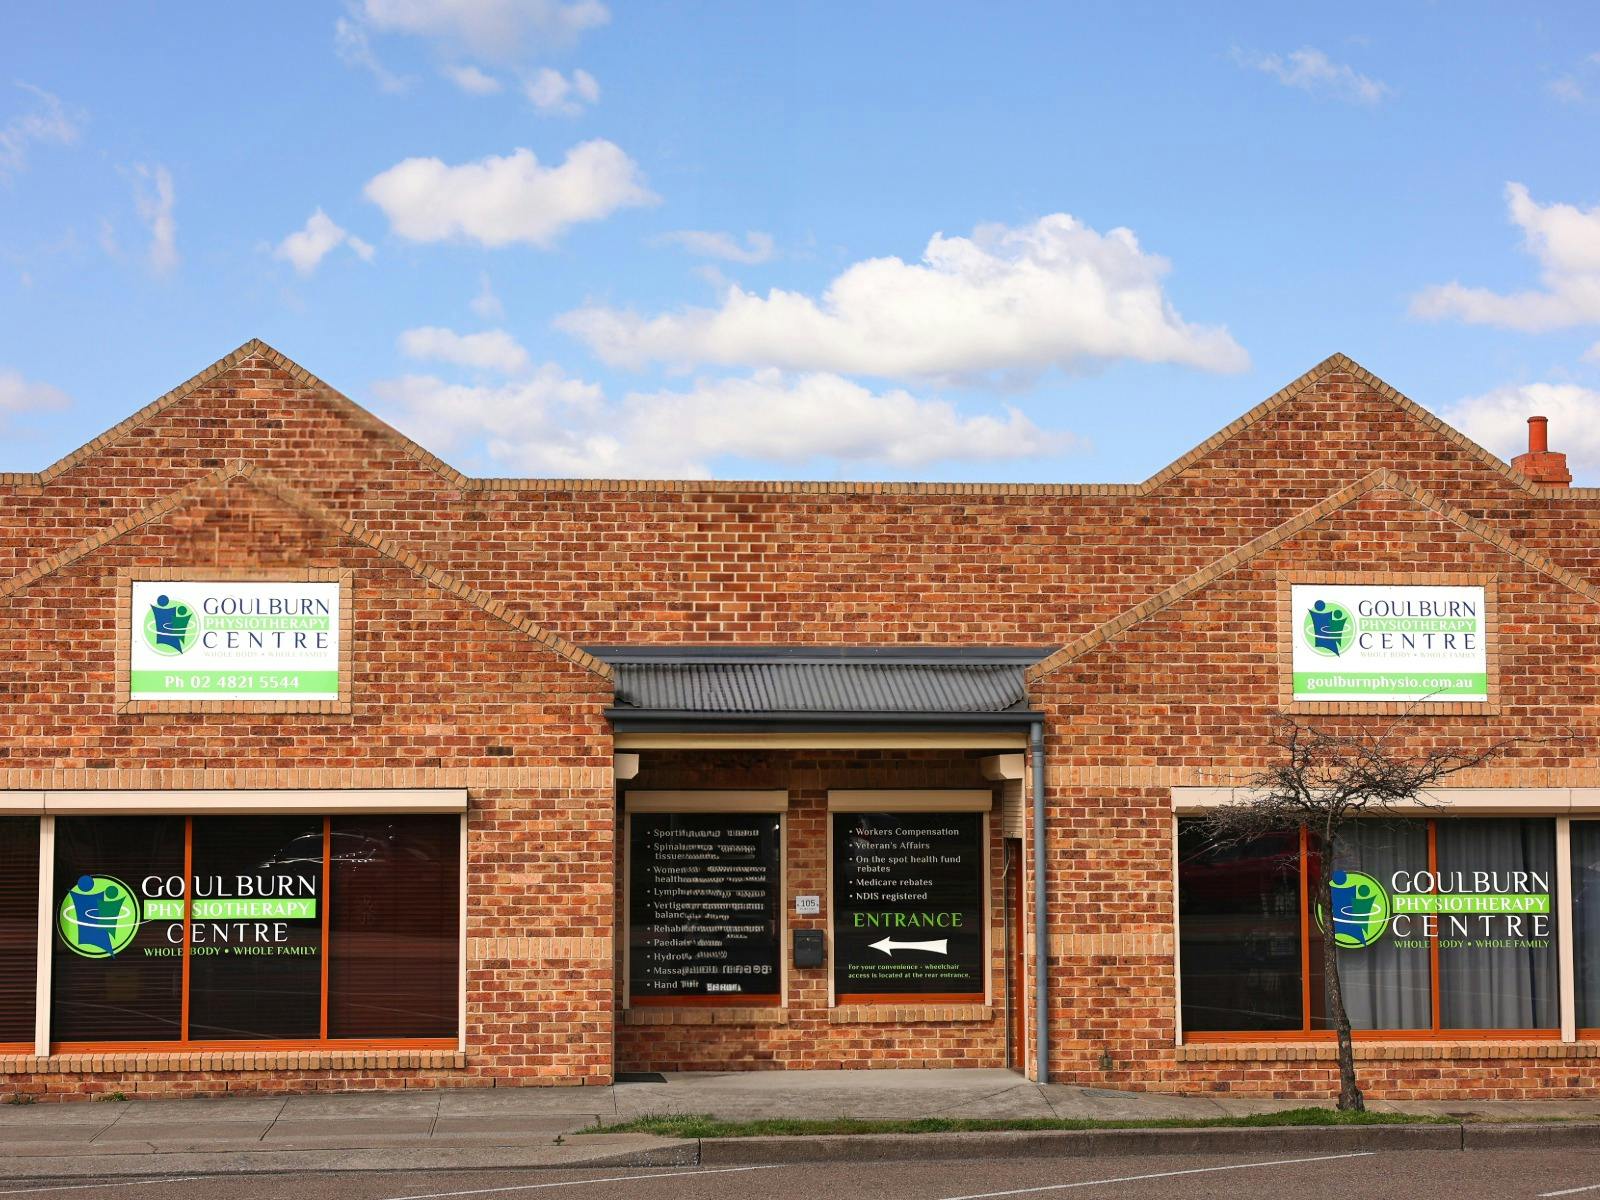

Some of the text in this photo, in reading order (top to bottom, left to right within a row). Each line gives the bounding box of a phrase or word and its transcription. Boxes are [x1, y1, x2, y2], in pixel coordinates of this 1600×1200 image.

[203, 597, 329, 615] GOULBURN
[1358, 600, 1476, 617] GOULBURN
[205, 617, 328, 630] PHYSIOTHERAPY
[1360, 619, 1474, 631] PHYSIOTHERAPY
[203, 631, 328, 649] CENTRE
[1358, 633, 1476, 650] CENTRE
[164, 675, 300, 689] Ph 02 4821 5544
[1307, 675, 1473, 690] goulburnphysio.com.au
[855, 828, 960, 837] Workers Compensation
[855, 841, 930, 849] Veteran's Affairs
[871, 855, 886, 863] the
[888, 856, 908, 864] spot
[910, 855, 938, 863] health
[940, 855, 961, 863] fund
[857, 865, 891, 873] rebates
[141, 875, 316, 898] GOULBURN
[856, 878, 933, 886] Medicare rebates
[1391, 870, 1549, 893] GOULBURN
[800, 899, 816, 907] 105
[881, 892, 928, 902] registered
[1395, 897, 1546, 911] PHYSIOTHERAPY
[147, 902, 309, 917] PHYSIOTHERAPY
[853, 912, 963, 928] ENTRANCE
[1392, 914, 1550, 938] CENTRE
[166, 922, 288, 944] CENTRE
[1393, 940, 1430, 948] WHOLE
[1475, 940, 1511, 948] WHOLE
[1514, 940, 1550, 948] FAMILY
[143, 946, 317, 957] WHOLE BODY WHOLE FAMILY
